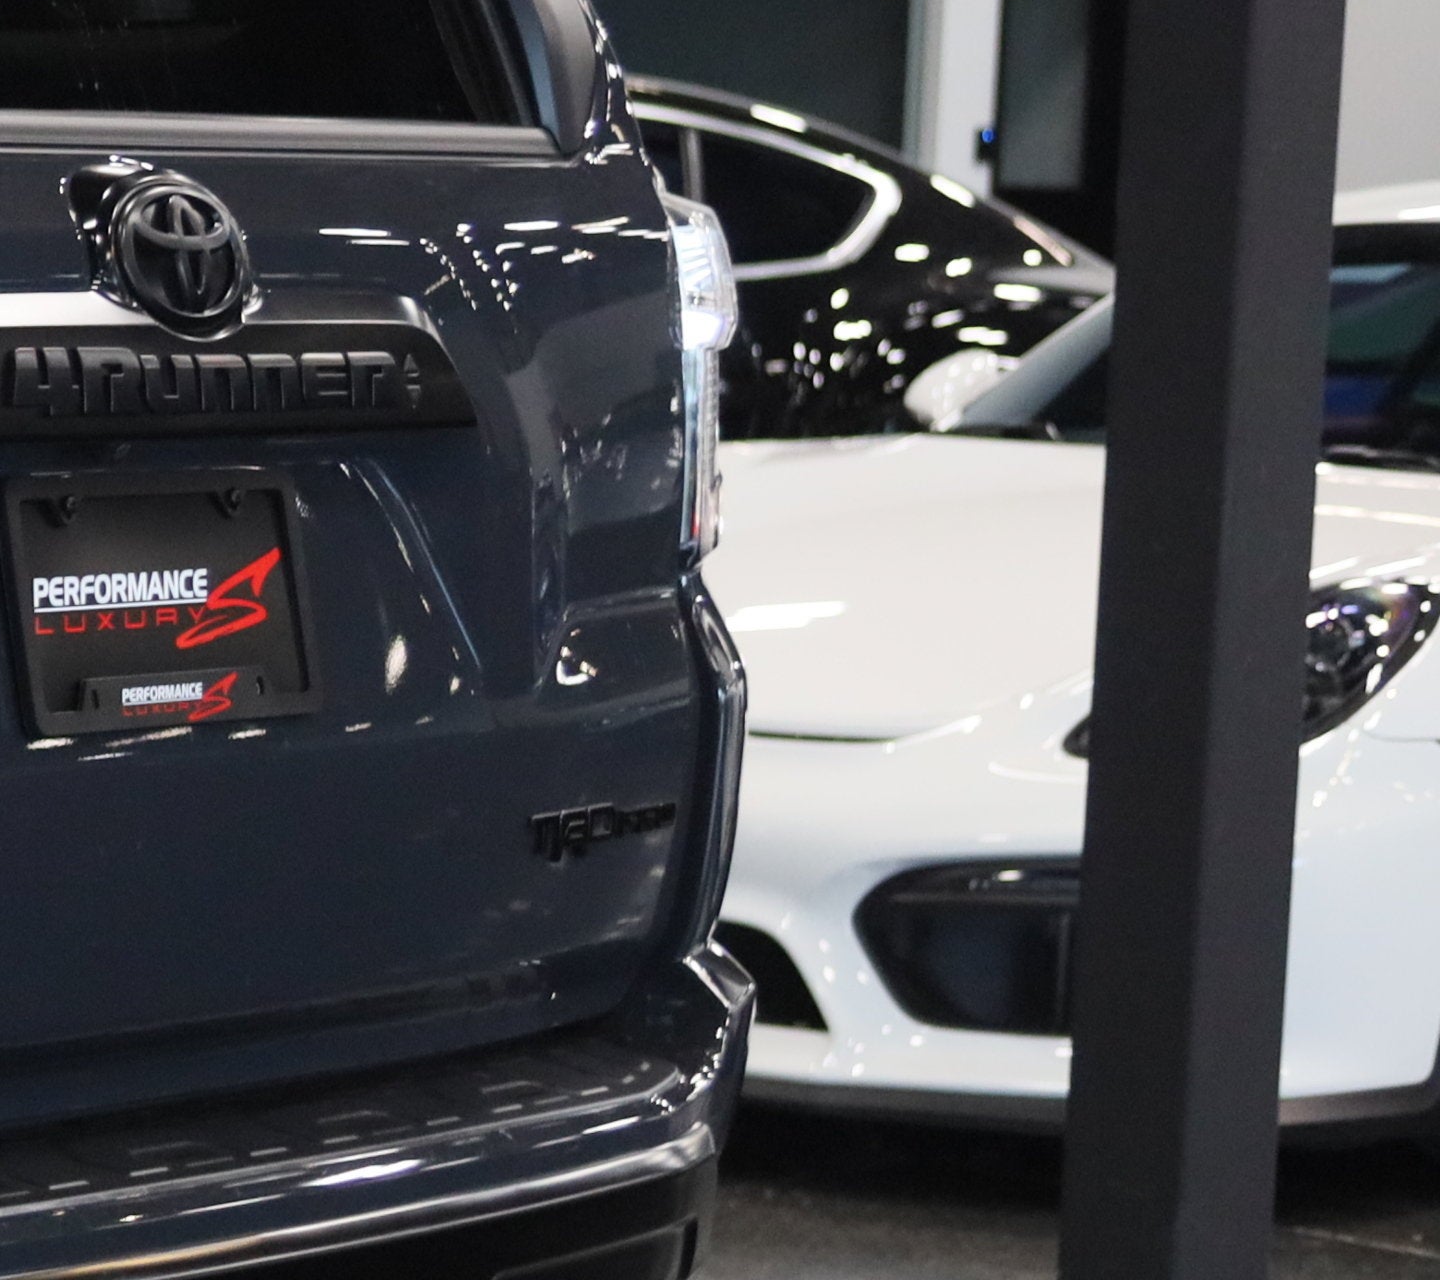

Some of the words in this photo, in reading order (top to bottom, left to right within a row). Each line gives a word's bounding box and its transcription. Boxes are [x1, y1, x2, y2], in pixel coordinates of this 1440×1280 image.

[33, 569, 207, 608] PERFORMANCE
[35, 607, 206, 635] LUXURY
[122, 682, 203, 703] PERFORMANCE
